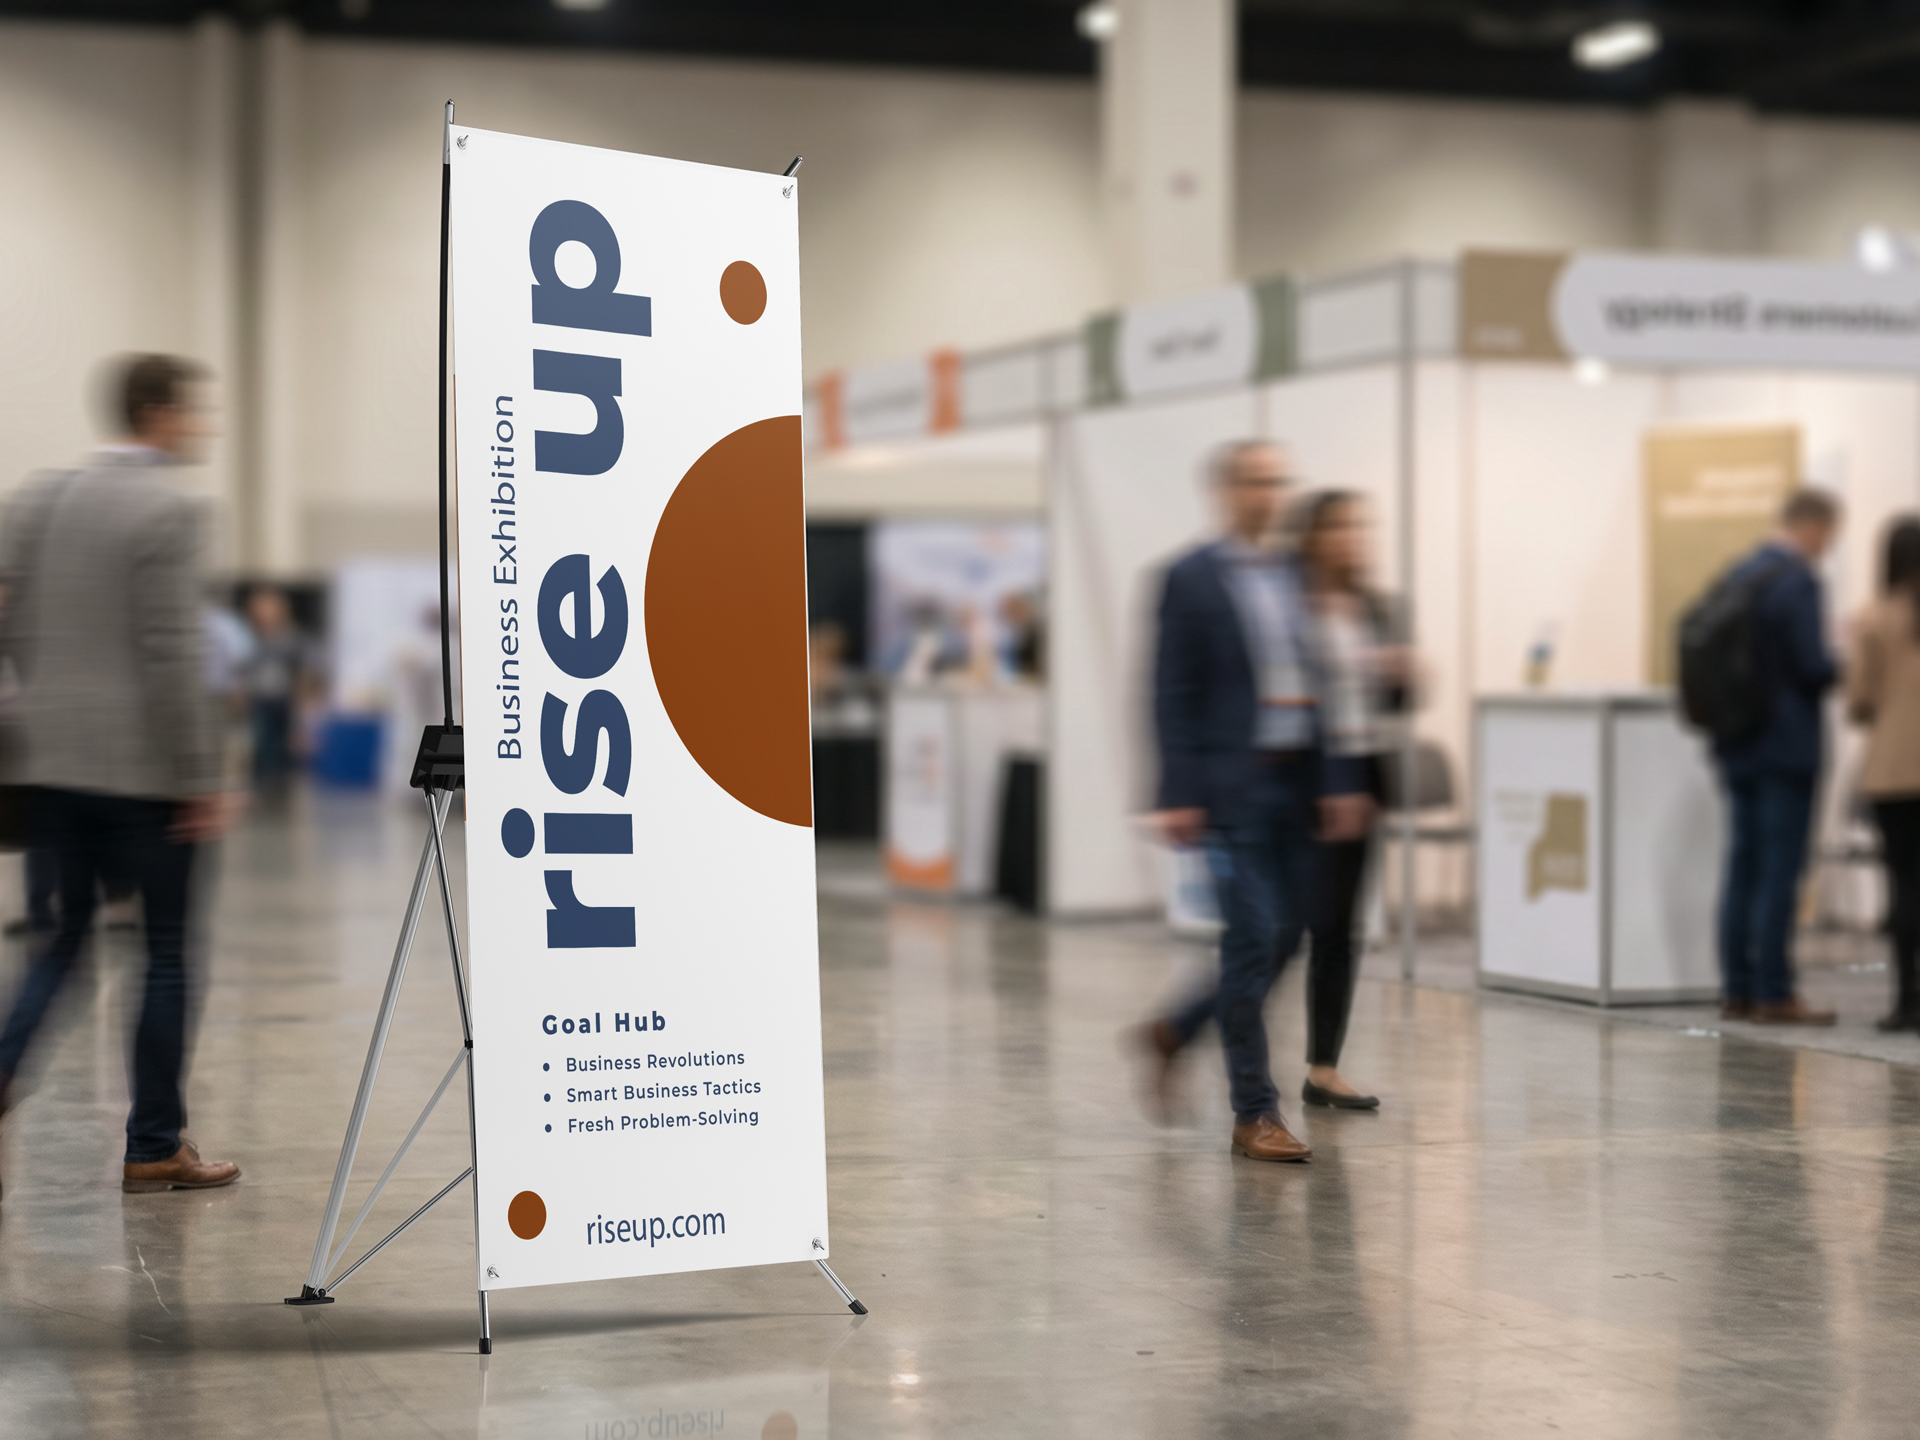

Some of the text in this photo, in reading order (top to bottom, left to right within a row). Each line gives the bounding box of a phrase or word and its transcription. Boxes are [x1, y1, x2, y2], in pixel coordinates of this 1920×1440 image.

[491, 395, 522, 760] Business Exhibition
[501, 199, 653, 949] rise up
[541, 1010, 666, 1036] Goal Hub
[566, 1050, 745, 1073] Business Revolutions
[566, 1078, 762, 1103] Smart Business Tactics
[568, 1109, 759, 1133] Fresh Problem-Solving
[587, 1212, 726, 1248] riseup.com
